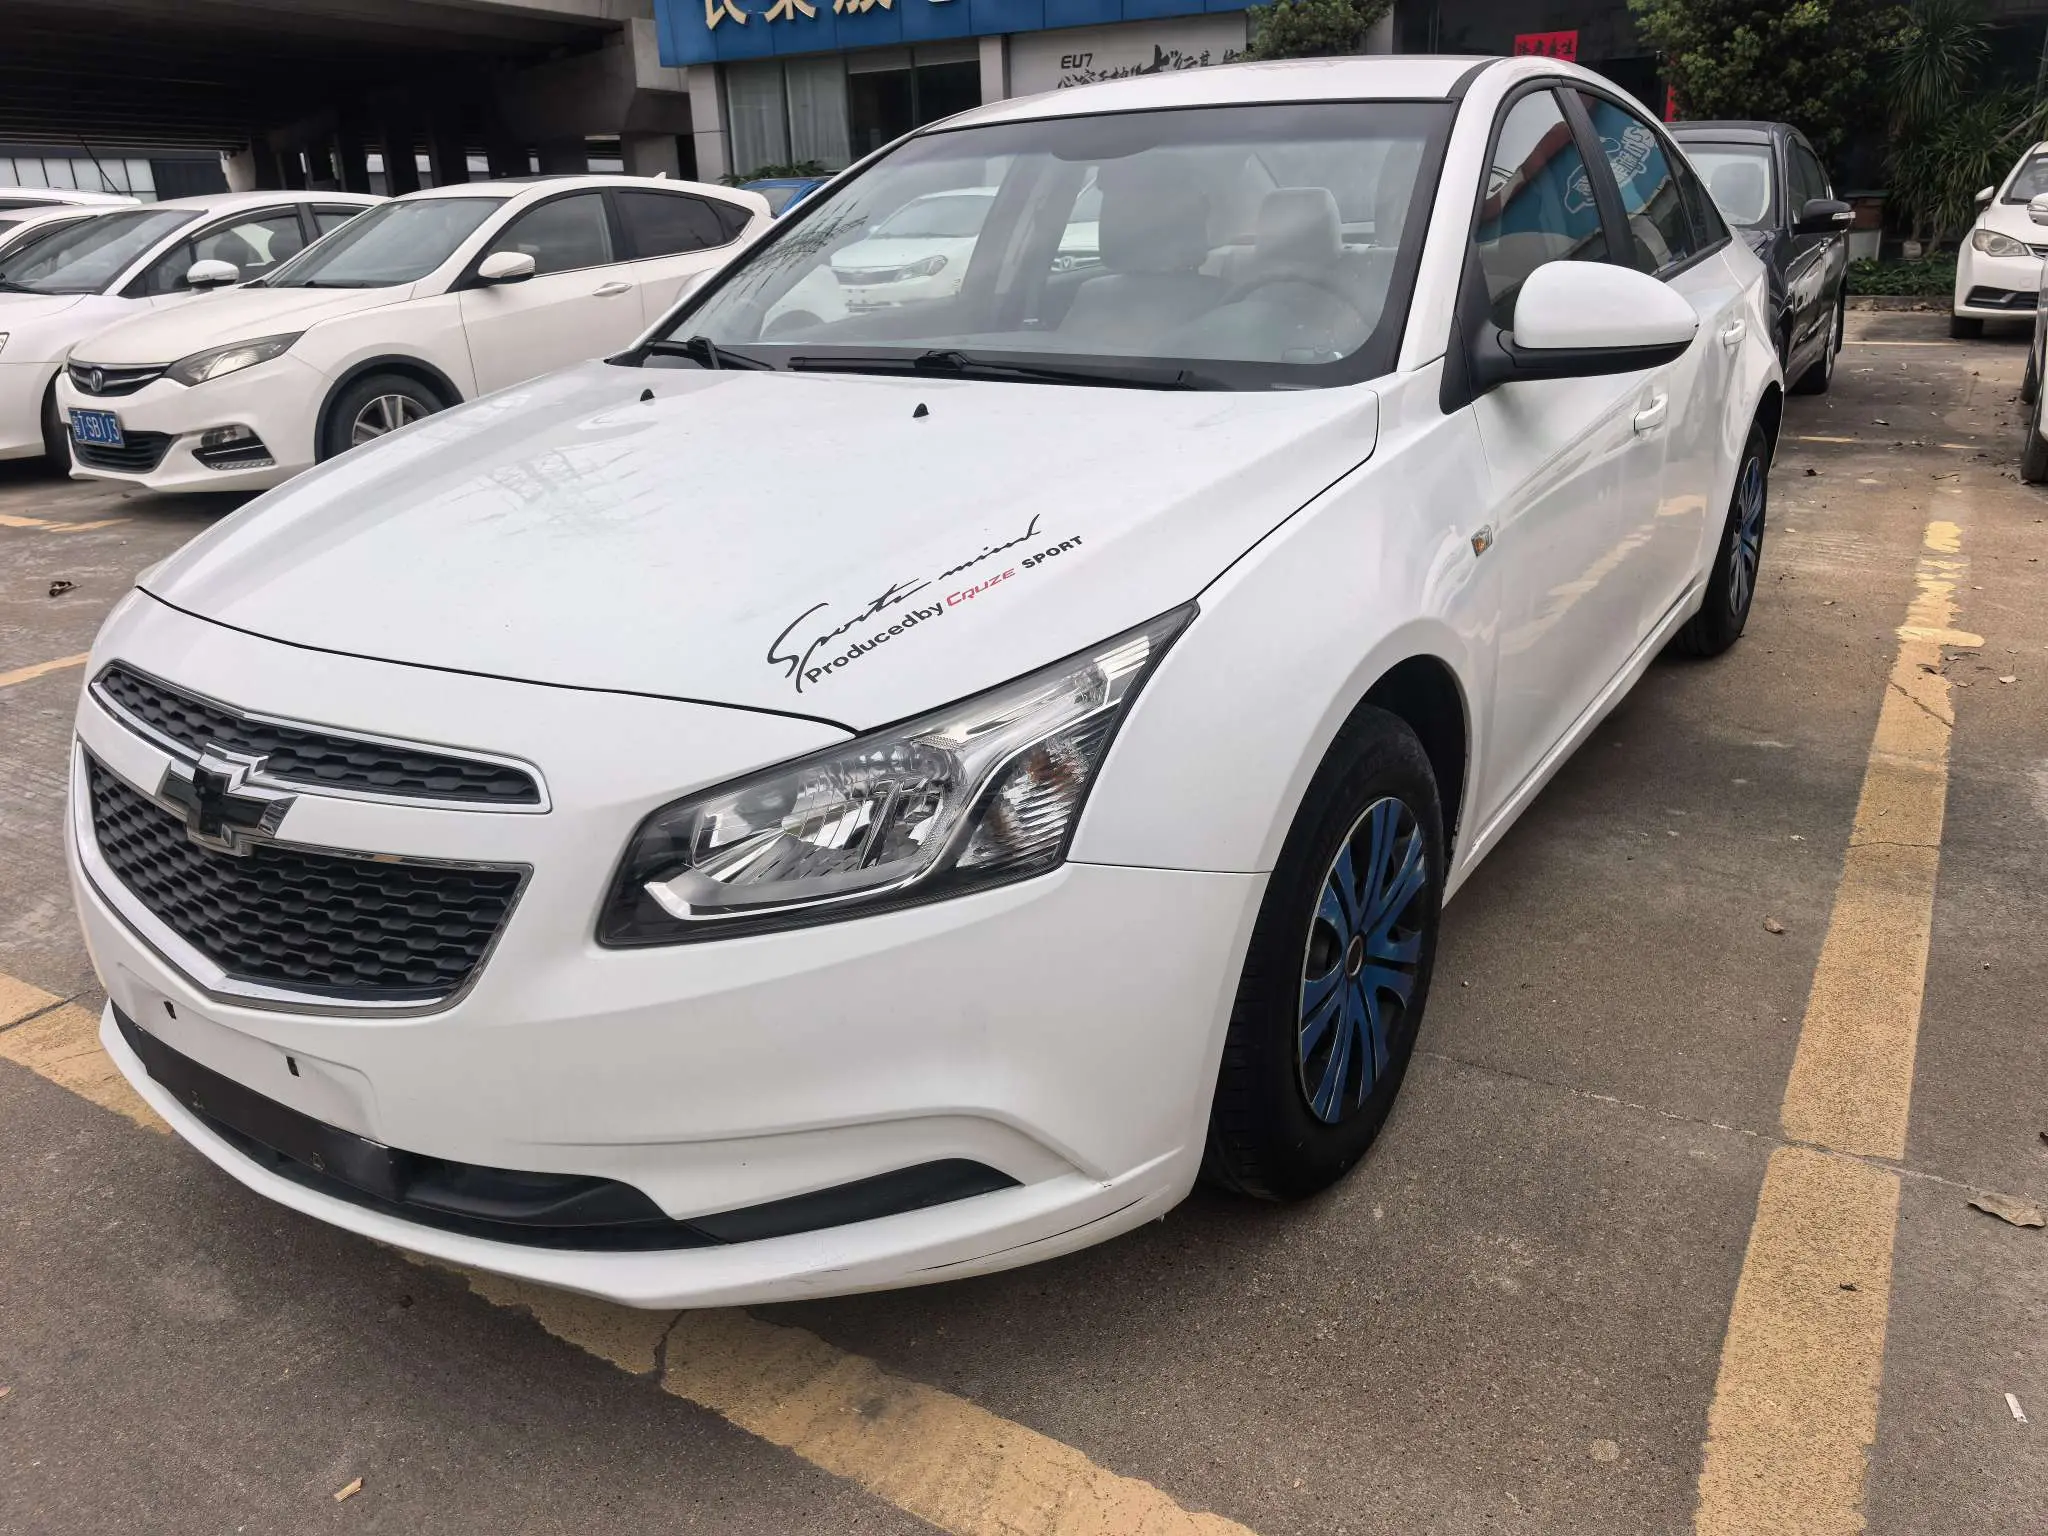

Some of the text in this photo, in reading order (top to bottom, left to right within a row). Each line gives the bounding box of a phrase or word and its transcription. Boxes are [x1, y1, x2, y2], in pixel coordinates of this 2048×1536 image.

[1060, 53, 1094, 70] EU7
[946, 568, 1017, 608] CRUZE
[1021, 535, 1084, 569] SPORT
